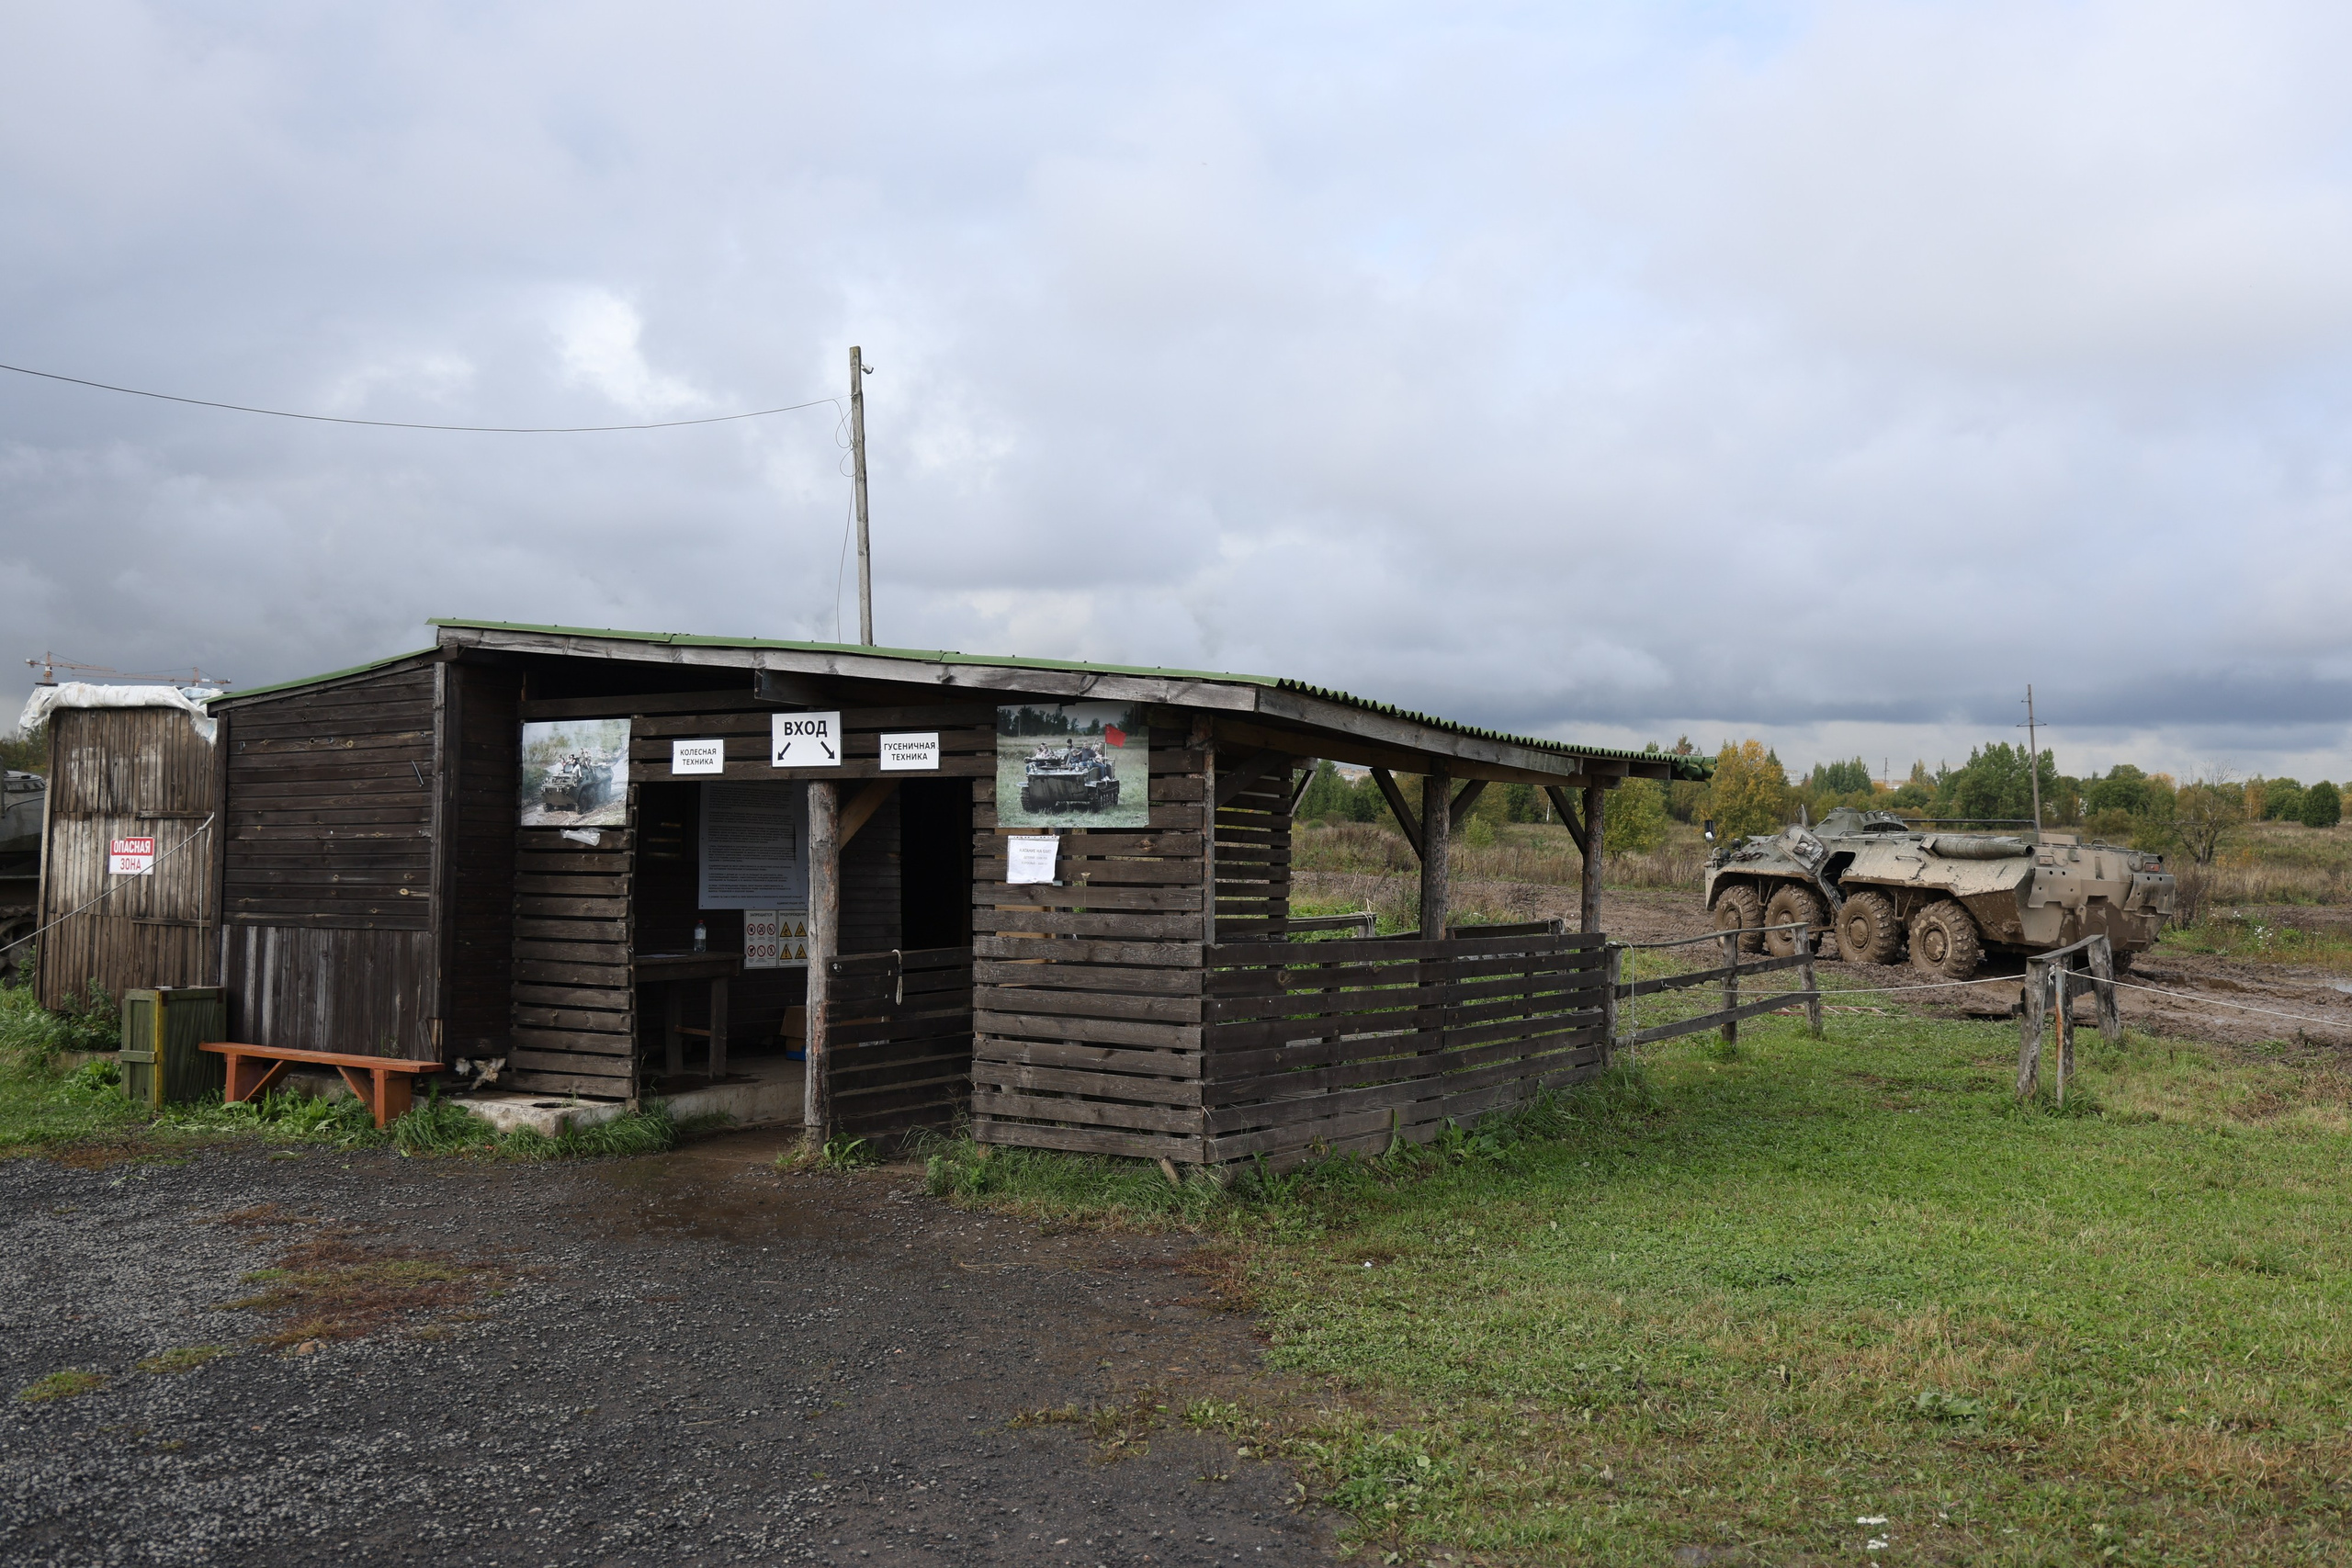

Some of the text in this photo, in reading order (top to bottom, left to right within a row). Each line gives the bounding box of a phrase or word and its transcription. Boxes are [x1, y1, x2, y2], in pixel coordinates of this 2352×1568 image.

[784, 720, 828, 738] ВХОД
[884, 742, 935, 750] ГУСЕНИЧНАЯ
[680, 748, 717, 756] КОЛЕСНАЯ
[891, 752, 928, 761] ТЕХНИКА
[683, 758, 714, 766] ТЕХНИКА
[113, 840, 151, 853] ОПАСНАЯ
[119, 858, 141, 871] ЗОНА
